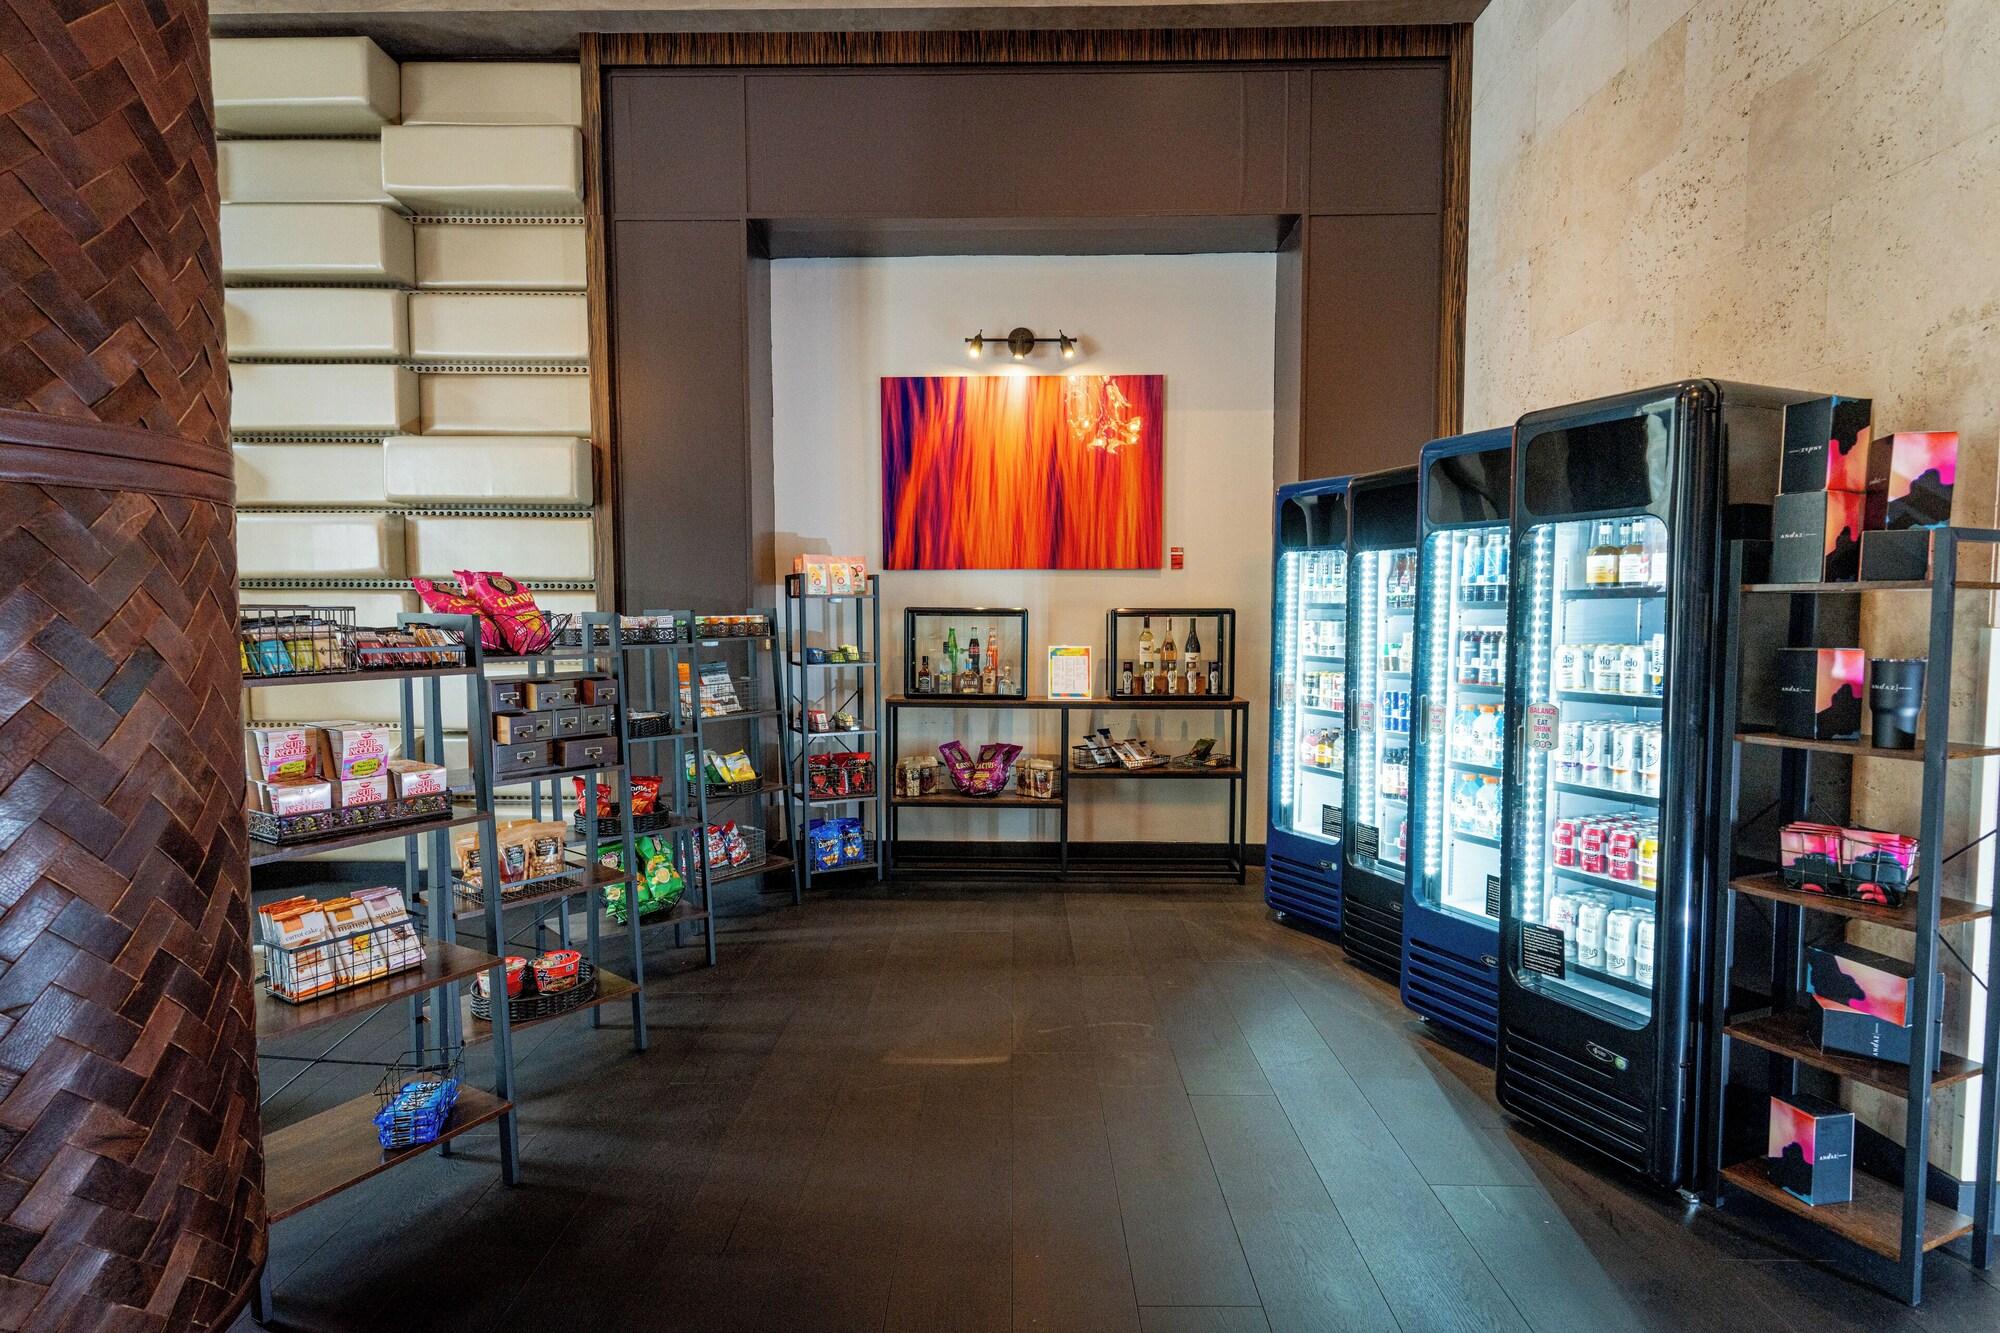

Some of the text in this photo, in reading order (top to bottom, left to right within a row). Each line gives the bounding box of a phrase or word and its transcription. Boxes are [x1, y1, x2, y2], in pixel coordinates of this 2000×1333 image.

[1529, 706, 1557, 716] BALANCE
[283, 739, 305, 749] CUP
[356, 738, 377, 748] CUP
[274, 745, 311, 758] NOODLES
[348, 744, 384, 757] NOODLES
[416, 779, 434, 787] CUP
[356, 787, 376, 796] CUP
[407, 783, 441, 796] NOODLES
[630, 785, 652, 794] oritos
[347, 793, 382, 806] NOODLES
[337, 920, 370, 932] mango
